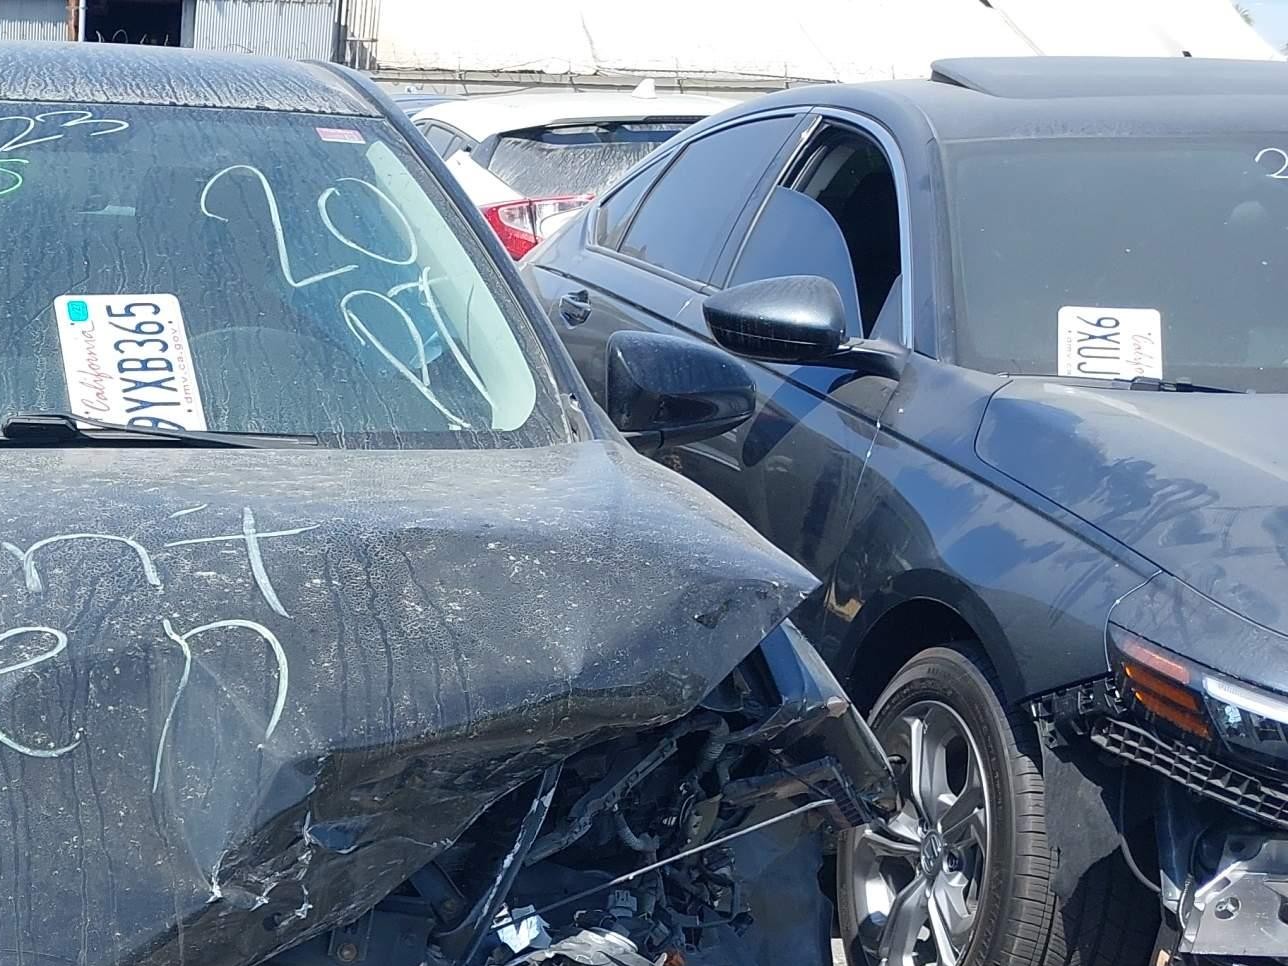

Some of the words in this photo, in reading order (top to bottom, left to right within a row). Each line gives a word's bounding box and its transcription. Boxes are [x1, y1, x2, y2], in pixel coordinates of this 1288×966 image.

[78, 319, 114, 413] California
[105, 302, 188, 432] 9YXB365
[170, 327, 194, 405] dmv.ca.gov
